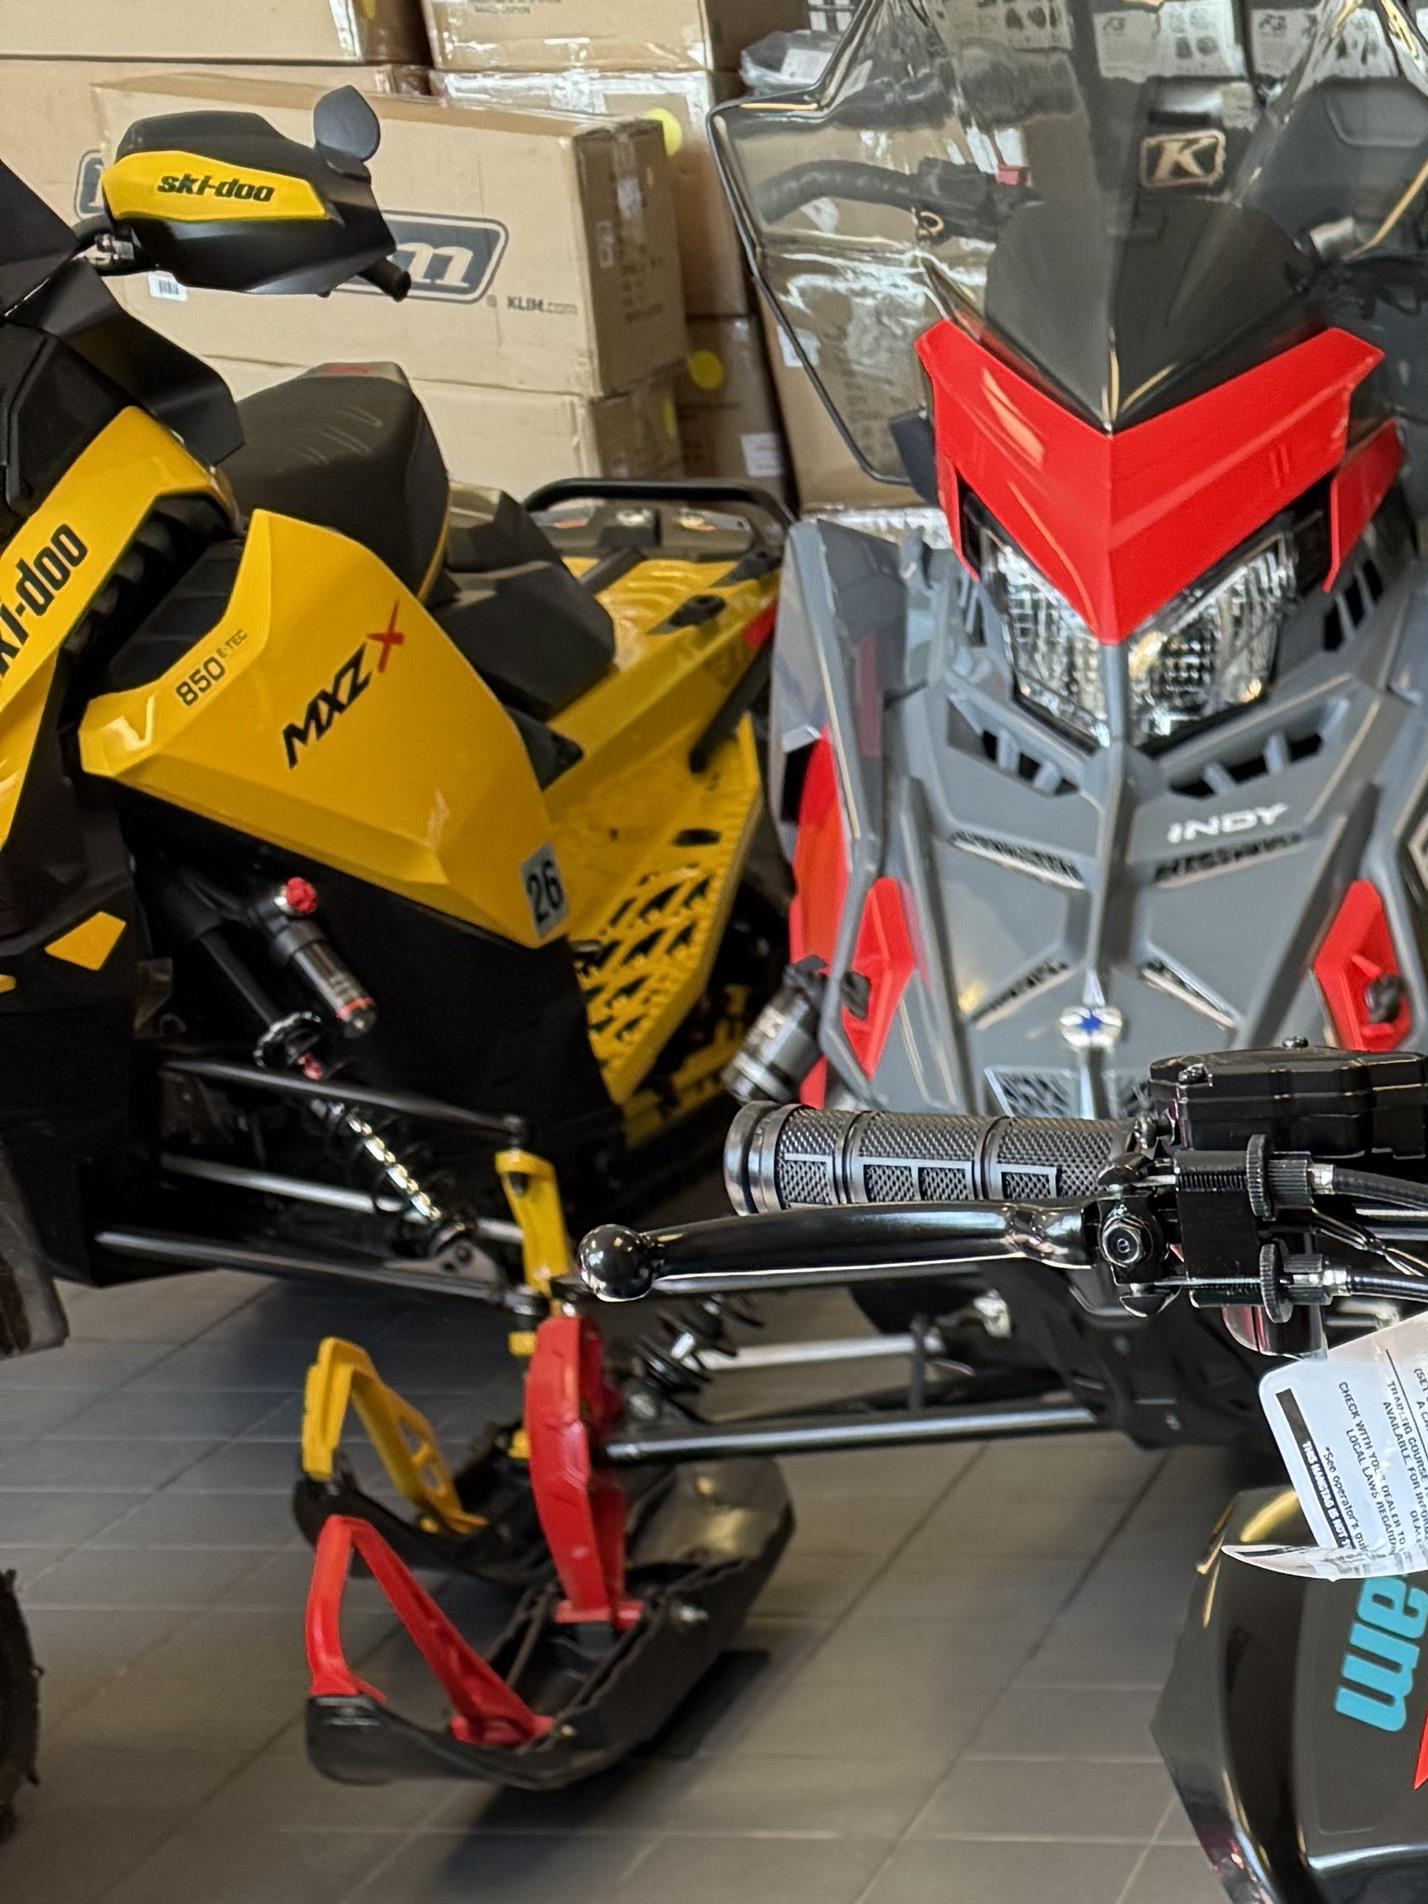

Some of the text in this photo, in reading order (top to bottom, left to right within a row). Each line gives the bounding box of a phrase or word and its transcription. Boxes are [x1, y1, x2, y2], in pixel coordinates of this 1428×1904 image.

[157, 173, 275, 203] ski-doo
[0, 523, 88, 683] ki-doo
[176, 656, 225, 706] 850
[283, 641, 373, 770] MXZ
[1167, 803, 1289, 844] INDY
[526, 859, 565, 925] 26
[1337, 1380, 1362, 1420] CHECK
[1353, 1419, 1374, 1450] WITH
[1344, 1427, 1368, 1466] LOCAL
[1360, 1466, 1381, 1499] LAWS
